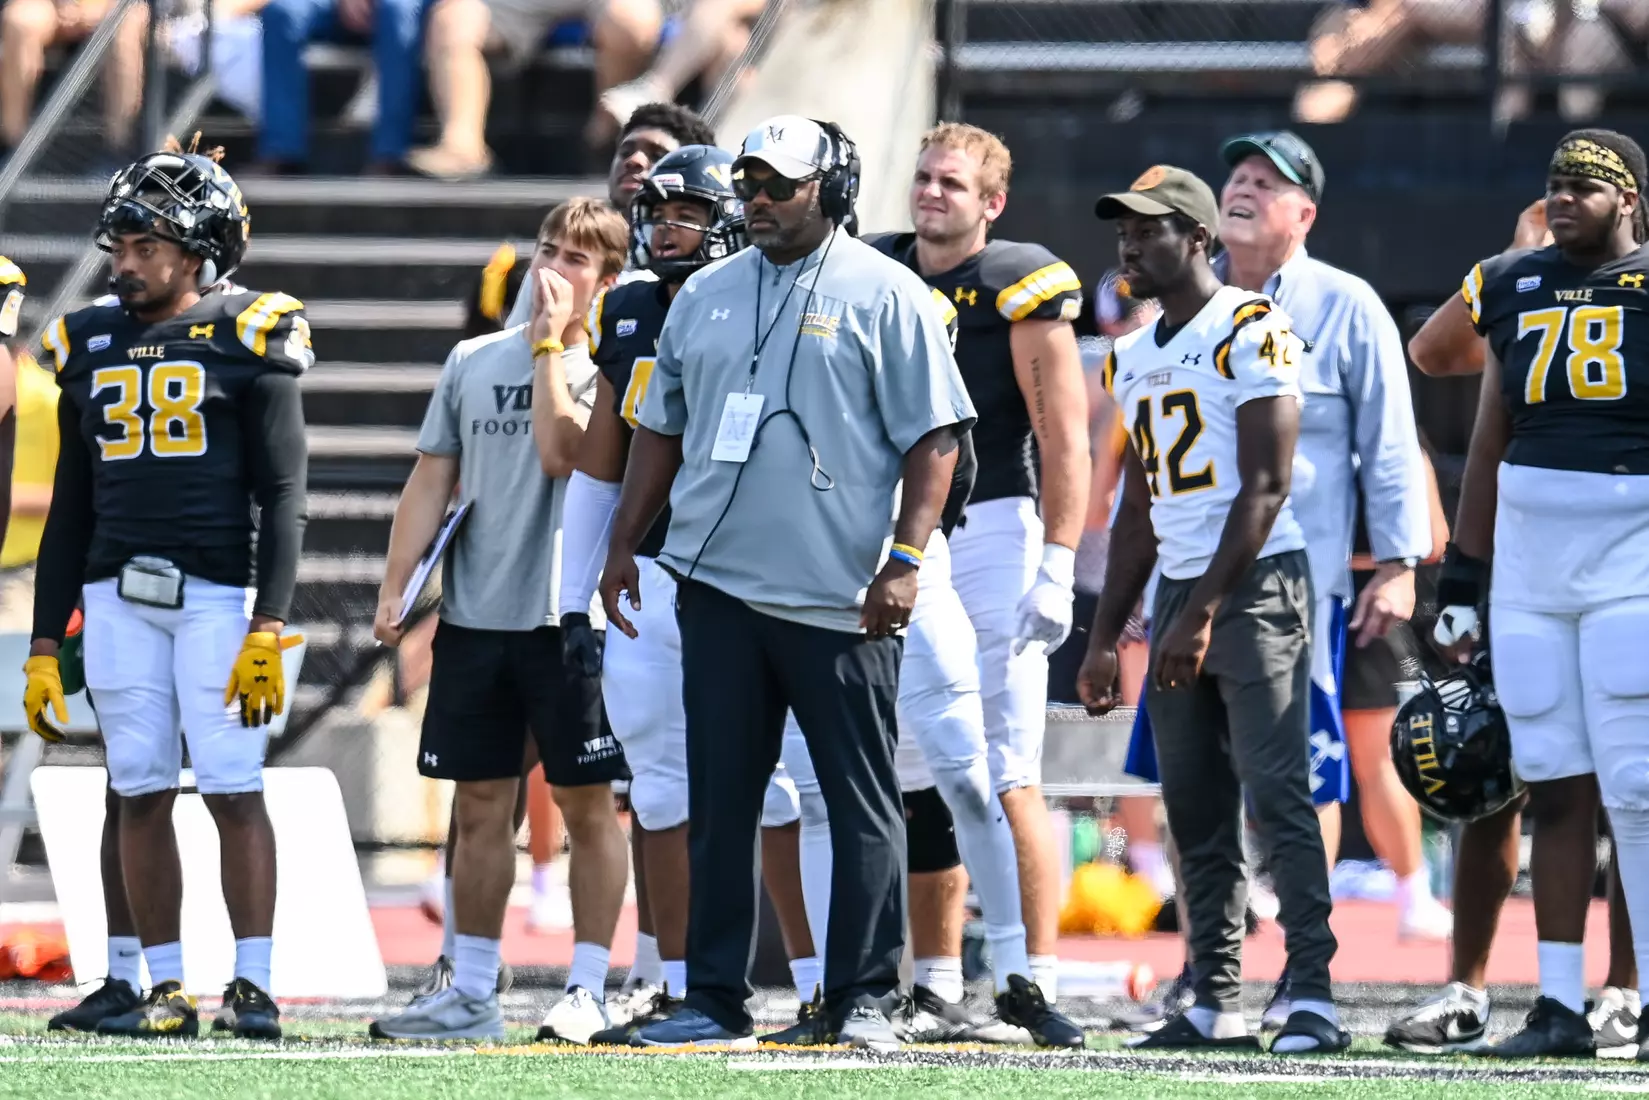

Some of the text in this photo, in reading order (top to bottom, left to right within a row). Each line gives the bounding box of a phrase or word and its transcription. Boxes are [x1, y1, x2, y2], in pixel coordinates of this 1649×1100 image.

[1554, 289, 1593, 302] VILLE
[127, 345, 165, 360] VILLE
[1517, 305, 1627, 405] 78
[90, 360, 208, 461] 38
[1133, 388, 1217, 497] 42
[1410, 712, 1446, 795] VILLE
